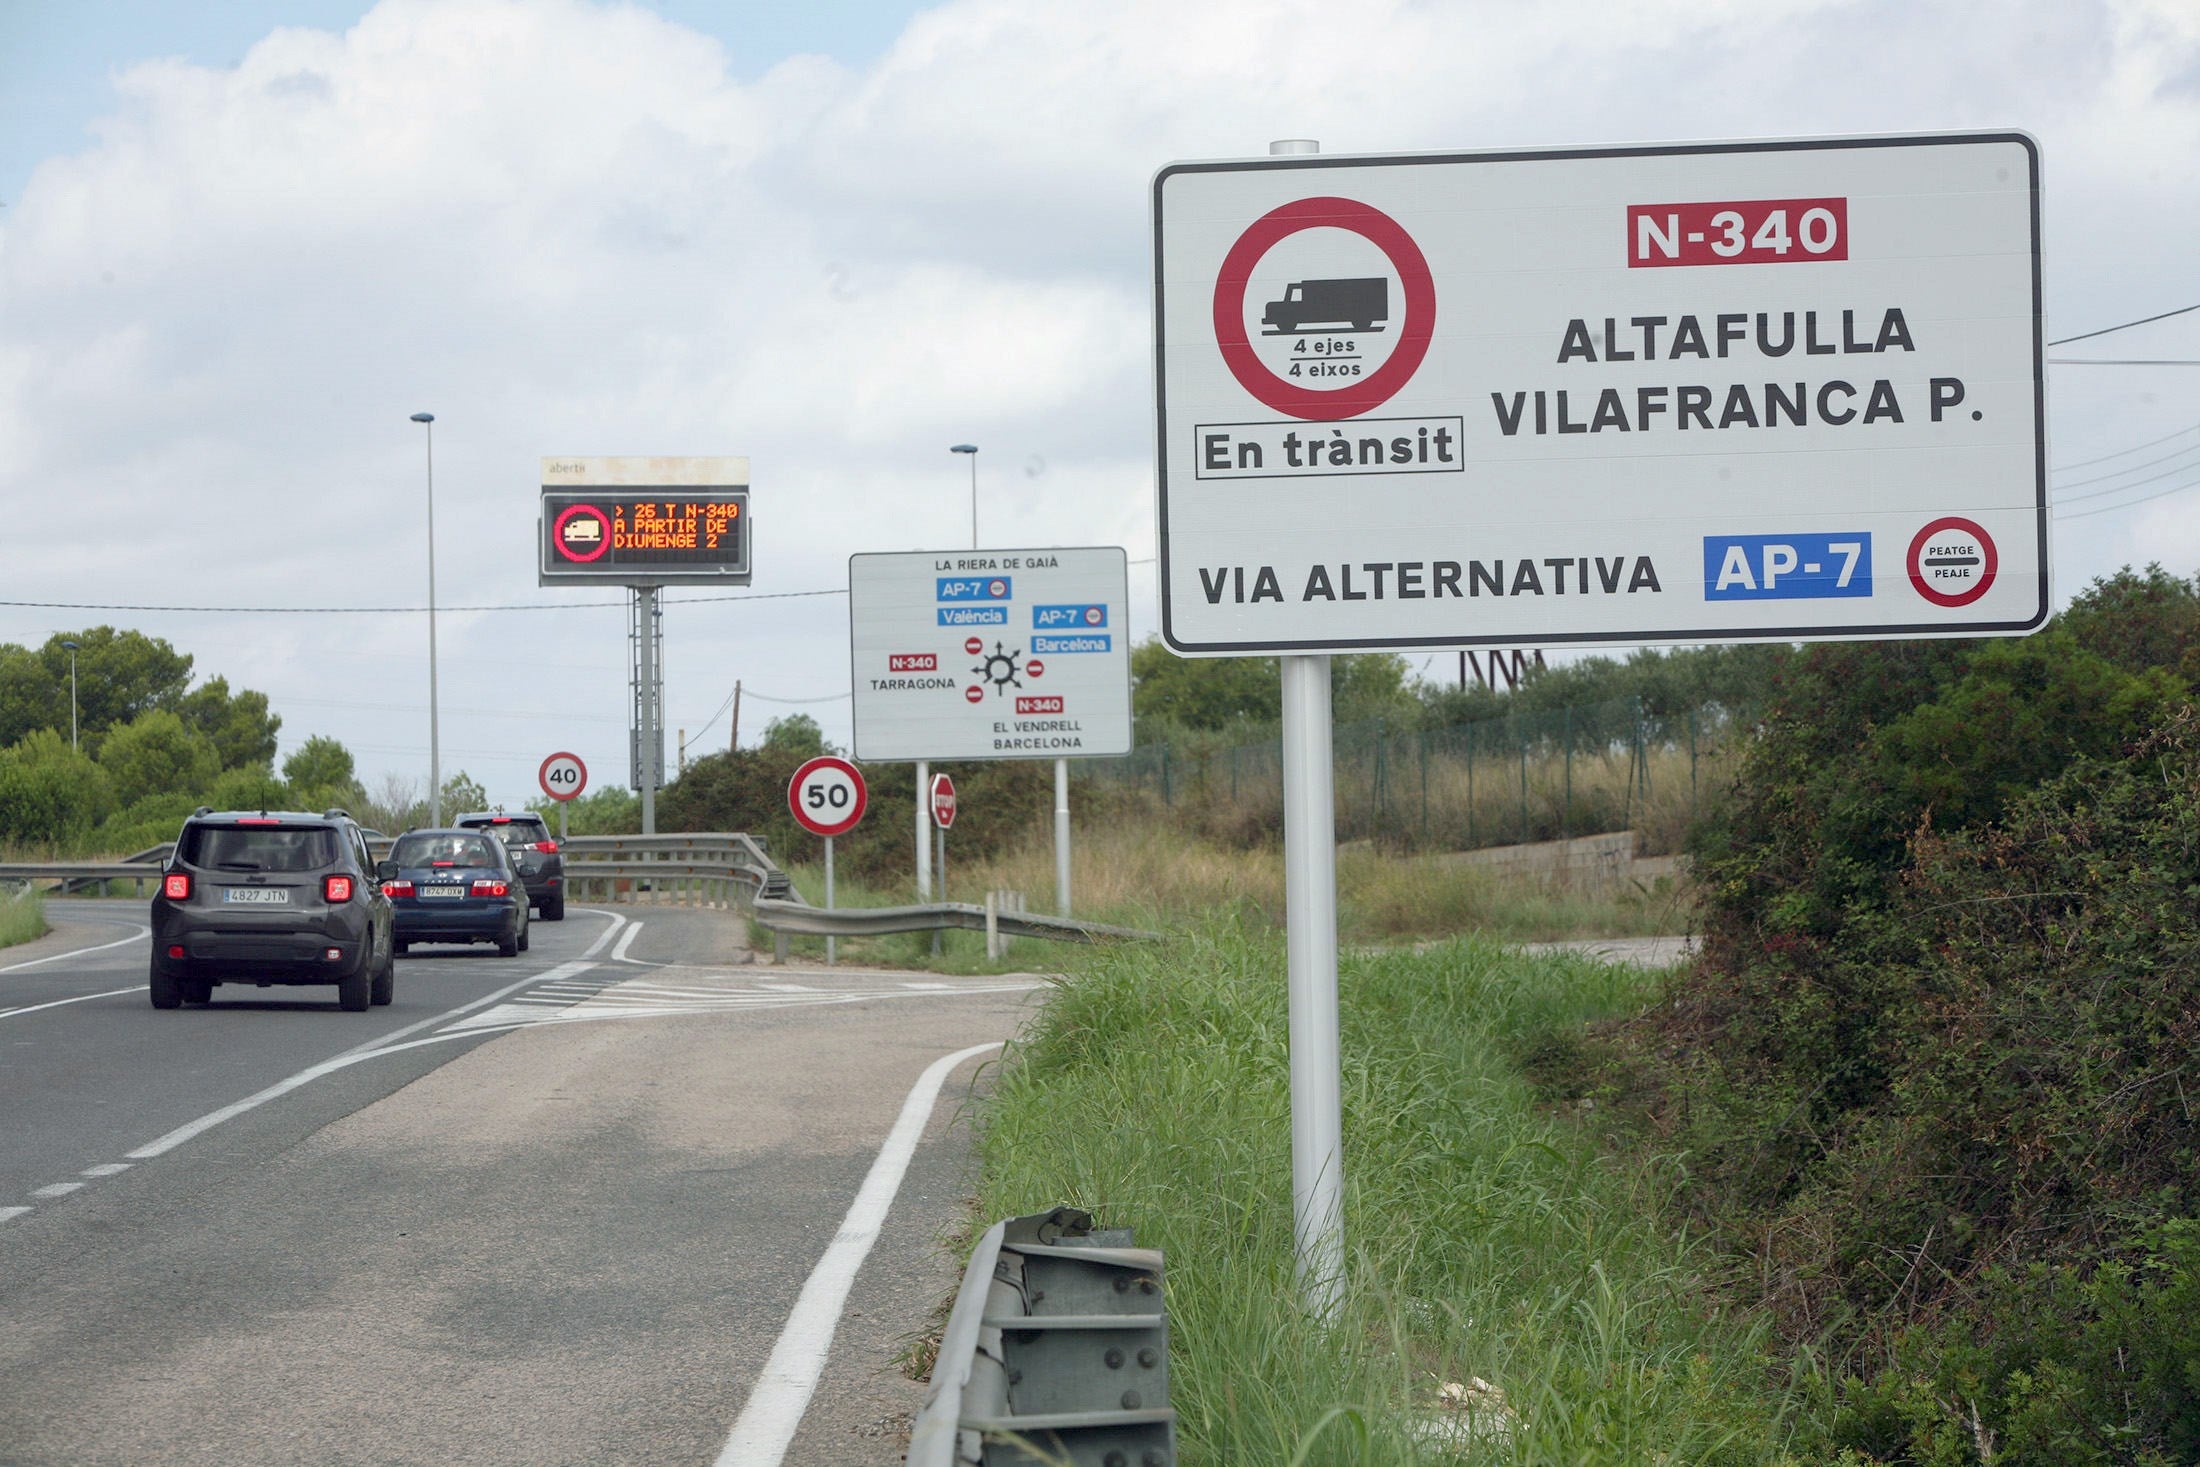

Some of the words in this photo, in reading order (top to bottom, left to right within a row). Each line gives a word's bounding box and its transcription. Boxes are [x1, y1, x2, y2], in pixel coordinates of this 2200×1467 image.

[1637, 207, 1840, 261] N-340
[1557, 308, 1916, 364] ALTAFULLA
[1294, 338, 1307, 353] 4
[1314, 338, 1355, 356] ejes
[1289, 362, 1302, 378] 4
[1309, 361, 1361, 377] eixos
[1491, 380, 1905, 436] VILAFRANCA
[1930, 377, 1983, 423] P.
[1205, 433, 1263, 470] En
[1283, 427, 1453, 468] trànsit
[634, 504, 656, 518] 26
[665, 504, 676, 518] T
[685, 504, 738, 518] N-340
[614, 519, 625, 533] A
[634, 519, 697, 533] PARTIR
[706, 519, 728, 533] DE
[614, 533, 697, 548] DIUMENGE
[706, 533, 719, 548] 2
[1929, 546, 1975, 556] PEATGE
[935, 560, 952, 571] LA
[957, 559, 998, 570] RIERA
[1002, 559, 1020, 569] DE
[1026, 555, 1059, 568] GAIÀ
[1198, 566, 1285, 605] VIA
[1302, 555, 1662, 602] ALTERNATIVA
[1715, 542, 1862, 592] AP-7
[1935, 568, 1970, 578] PEAJE
[942, 582, 982, 597] AP-7
[943, 609, 1003, 624] València
[1038, 610, 1078, 624] AP-7
[1035, 638, 1107, 652] Barcelona
[892, 657, 934, 669] N-340
[870, 678, 956, 691] TARRAGONA
[1018, 700, 1061, 711] N-340
[993, 722, 1009, 733] EL
[1014, 720, 1082, 732] VENDRELL
[993, 738, 1082, 750] BARCELONA
[549, 768, 577, 785] 40
[807, 784, 849, 809] 50
[232, 891, 260, 901] 4827
[264, 891, 286, 901] JTN
[426, 887, 446, 896] 8747
